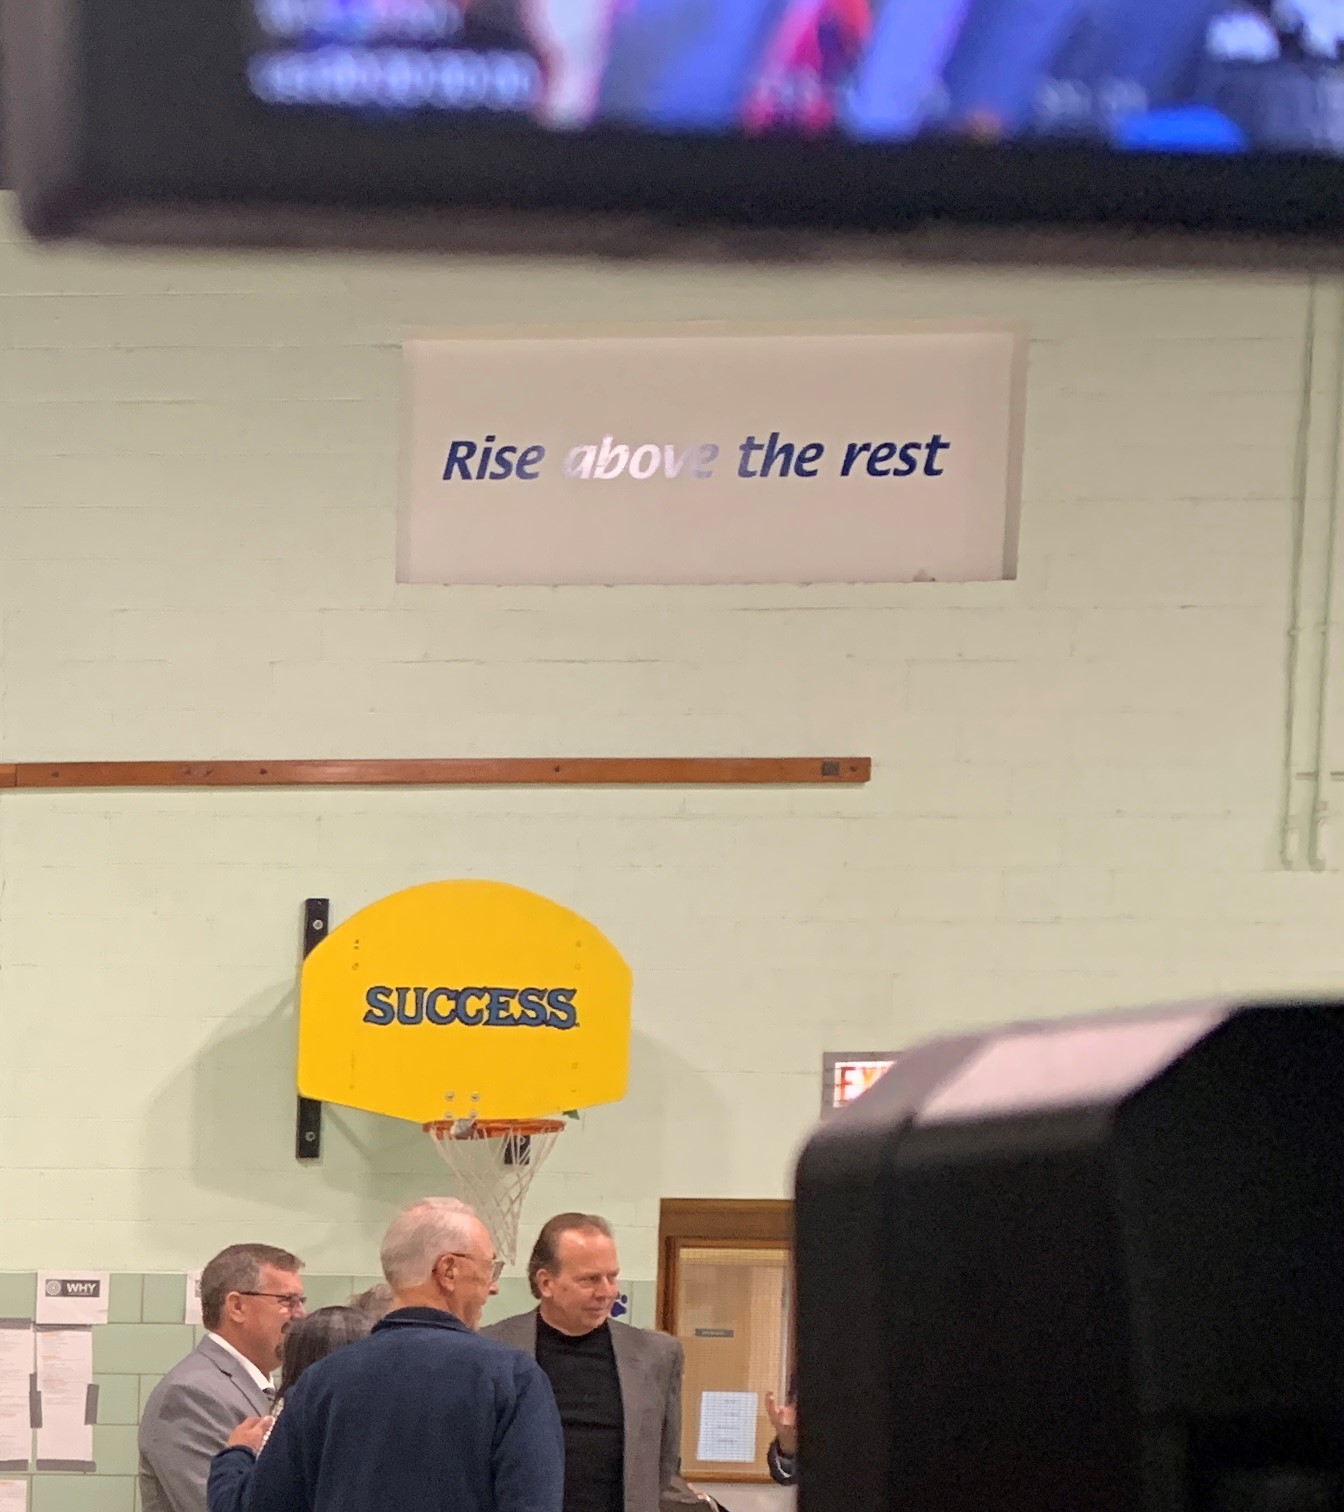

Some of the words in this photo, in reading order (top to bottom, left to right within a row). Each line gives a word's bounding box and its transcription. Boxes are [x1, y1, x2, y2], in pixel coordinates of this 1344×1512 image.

[442, 434, 545, 481] Rise
[561, 433, 719, 481] above
[738, 432, 824, 478] the
[840, 433, 950, 478] rest
[363, 985, 580, 1030] SUCCESS
[66, 1282, 97, 1294] WHY
